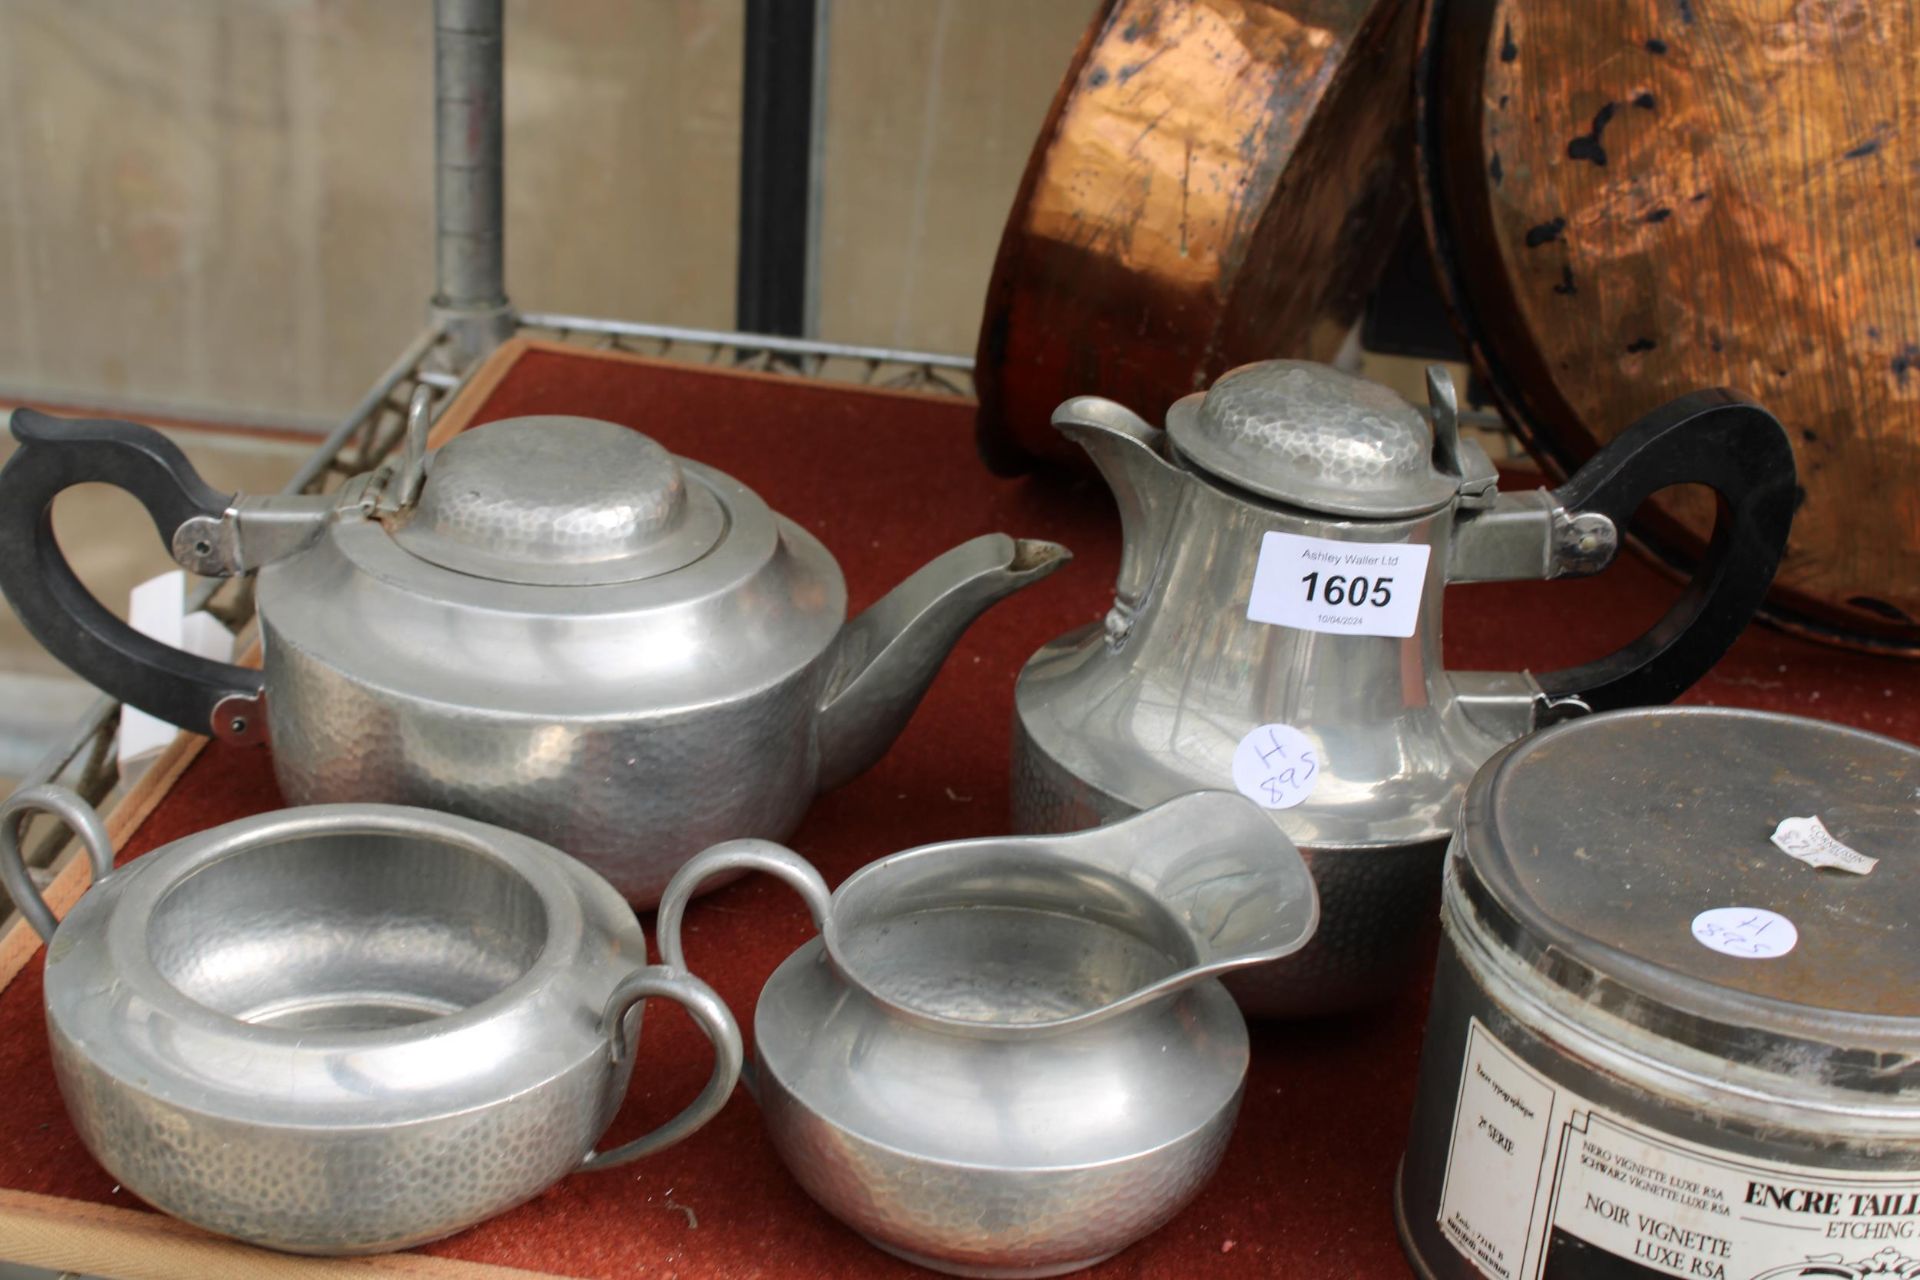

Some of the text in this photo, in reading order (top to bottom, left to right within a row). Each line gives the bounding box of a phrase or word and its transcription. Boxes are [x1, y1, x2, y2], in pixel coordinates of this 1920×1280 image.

[1301, 549, 1399, 567] Ashley Waller Ltd
[1302, 571, 1393, 608] 1605
[1317, 613, 1363, 625] 10/04/2024
[1253, 728, 1287, 769] H
[1580, 1154, 1731, 1217] SCHWARZ VIGNETTE LUXE RSA
[1583, 1141, 1724, 1201] NERO VIGNETTE LUXE RSA
[1745, 1180, 1842, 1216] ENCRE
[1584, 1191, 1733, 1259] NOIR VIGNETTE
[1825, 1221, 1914, 1239] ETCHING
[1634, 1238, 1727, 1280] LUXE RSA
